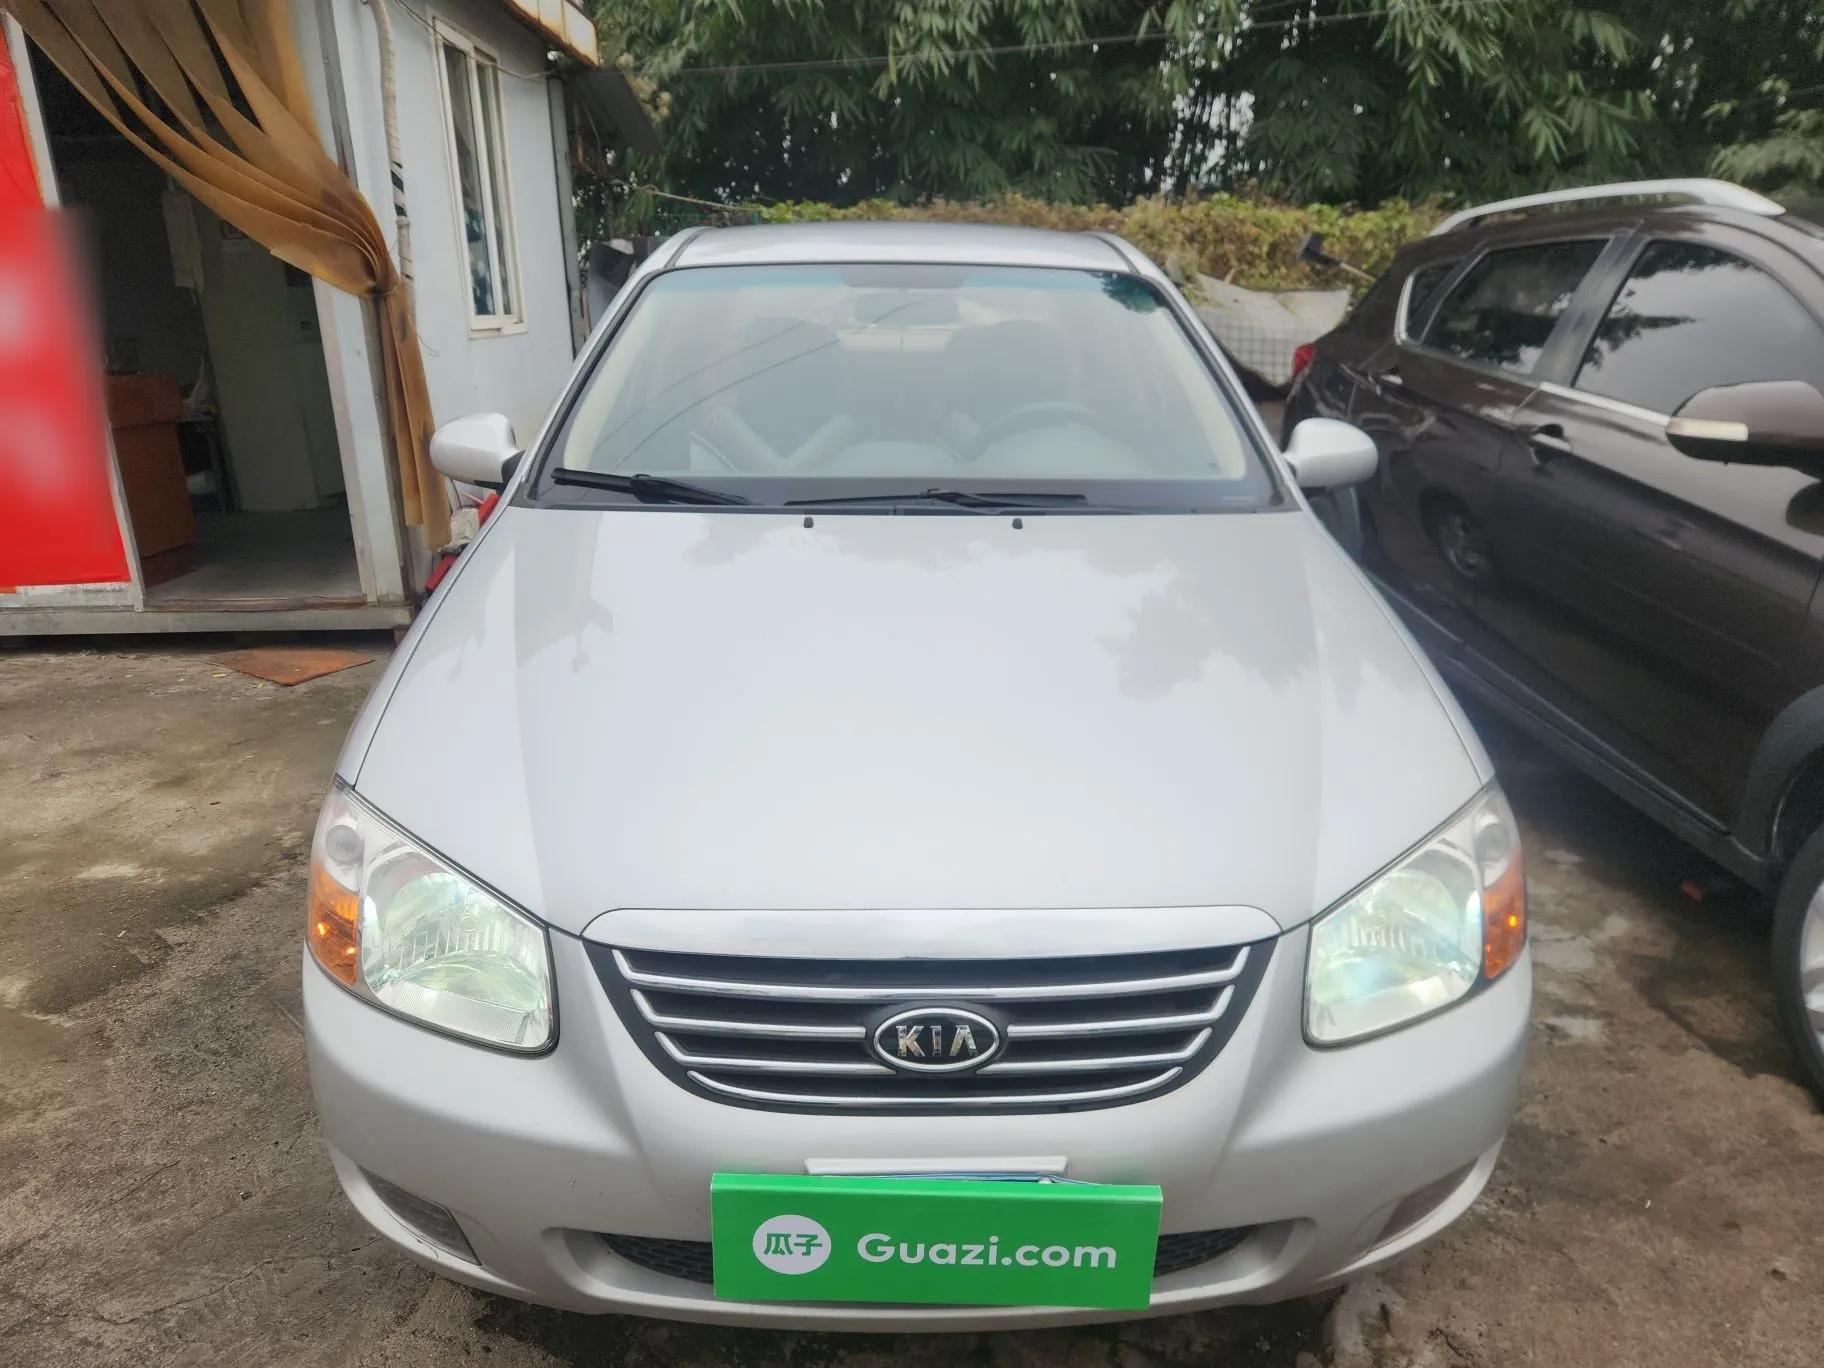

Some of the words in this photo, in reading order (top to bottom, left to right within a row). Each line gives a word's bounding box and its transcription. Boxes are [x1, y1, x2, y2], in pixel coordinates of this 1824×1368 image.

[895, 1024, 979, 1057] KIA
[763, 1232, 823, 1257] 瓜子
[857, 1232, 1117, 1269] Guazi.com
